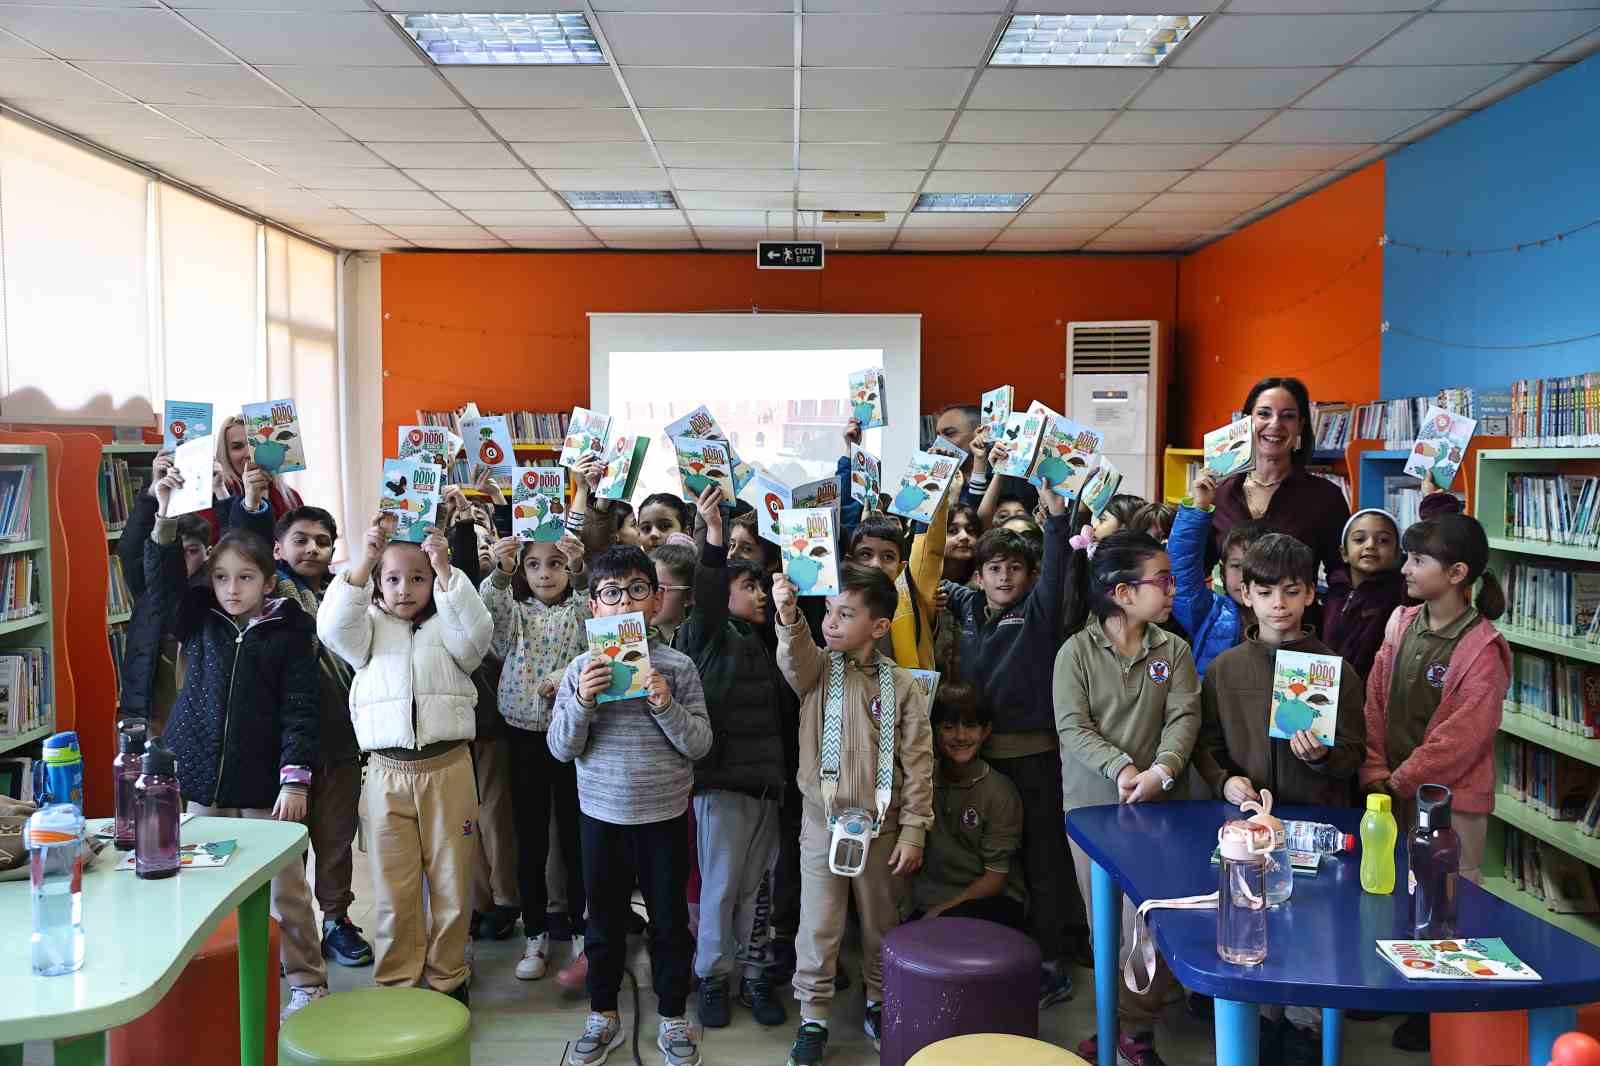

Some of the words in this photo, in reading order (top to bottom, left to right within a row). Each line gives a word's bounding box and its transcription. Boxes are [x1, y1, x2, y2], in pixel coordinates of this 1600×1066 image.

[424, 432, 444, 444] DODO
[413, 470, 436, 484] DODO
[540, 474, 560, 487] DODO
[618, 622, 642, 638] DODO
[1310, 663, 1336, 680] DODO
